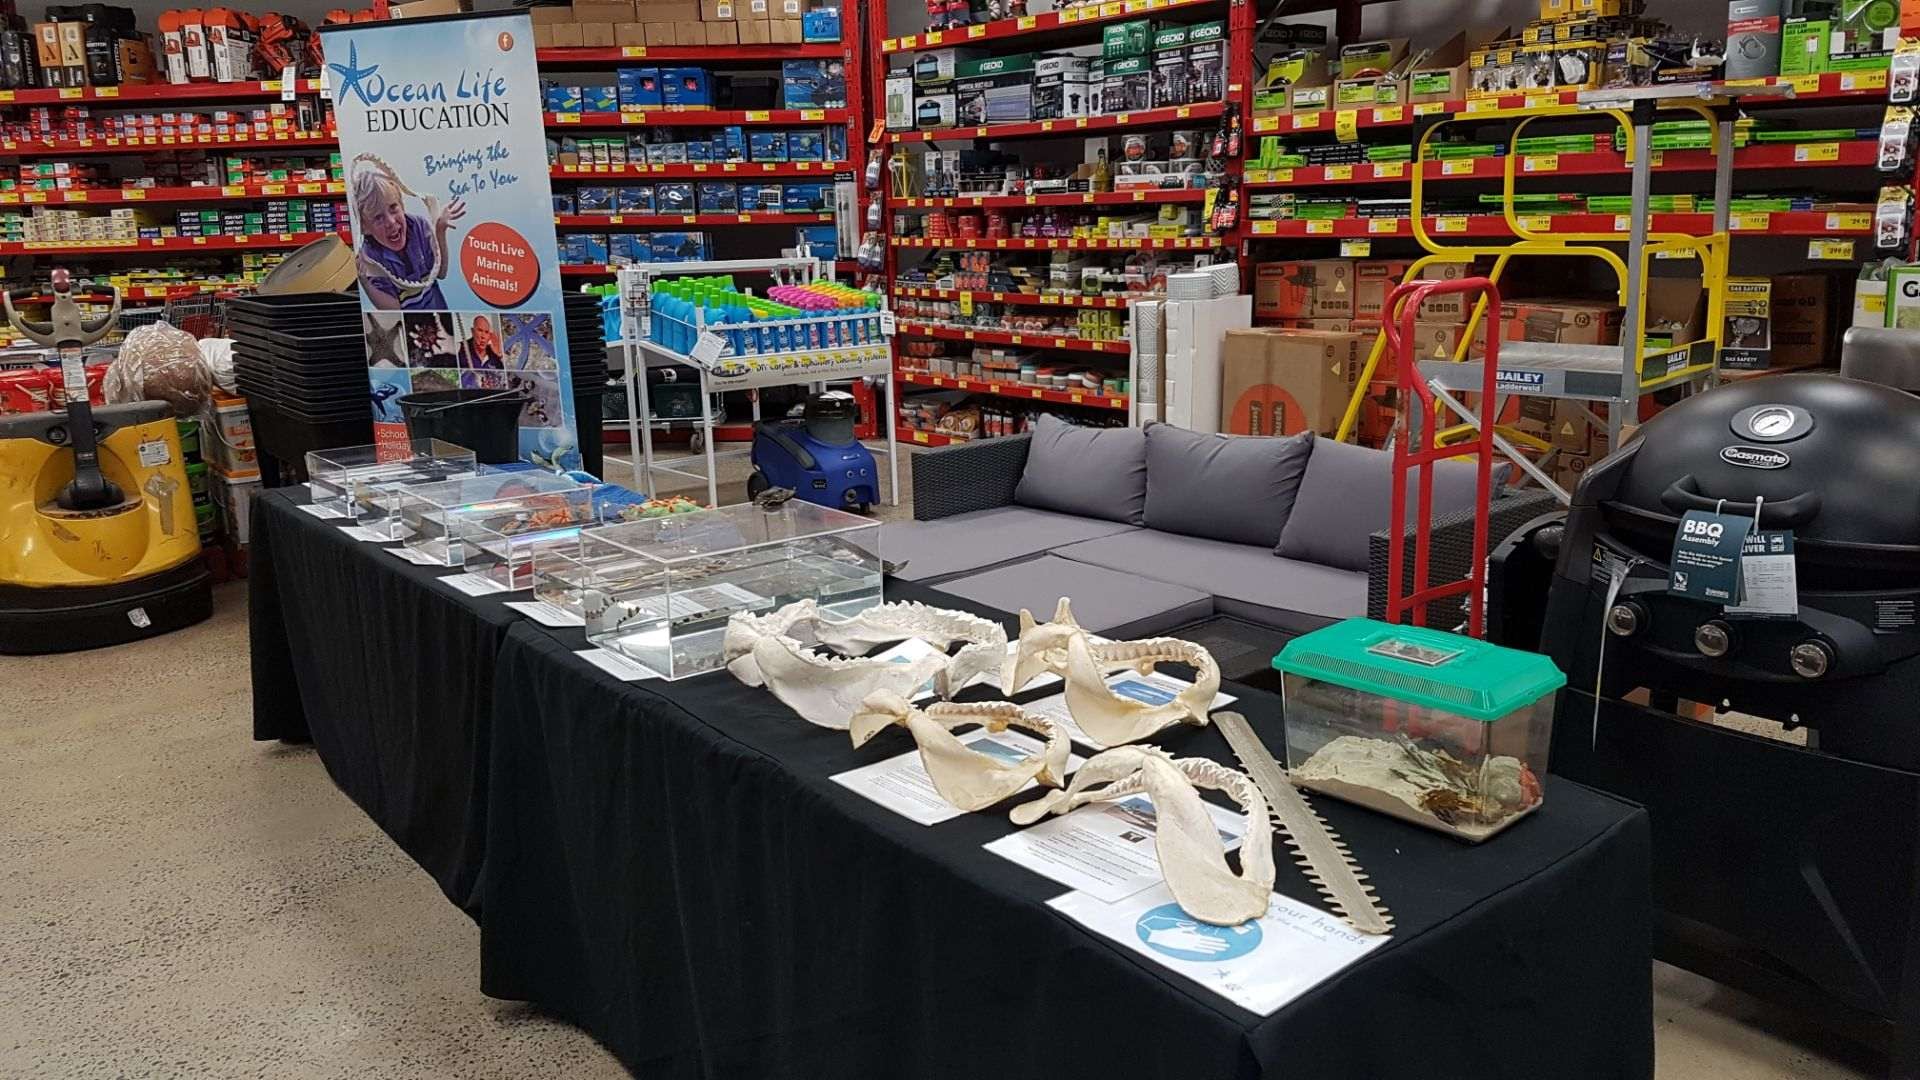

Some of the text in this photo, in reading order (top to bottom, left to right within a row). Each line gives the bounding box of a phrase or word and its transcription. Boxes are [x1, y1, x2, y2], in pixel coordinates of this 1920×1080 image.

[1160, 32, 1185, 44] GECKO
[1195, 26, 1221, 38] GECKO
[1117, 60, 1139, 70] GECKO
[366, 67, 507, 104] Ocean Life
[366, 102, 510, 132] EDUCATION
[424, 140, 509, 176] Bringing the
[448, 169, 518, 197] Sea To You
[468, 236, 525, 257] Touch Live
[476, 256, 513, 273] Marine
[472, 273, 518, 292] Animals!
[1902, 280, 1920, 297] G
[1496, 371, 1541, 383] BAILEY
[1725, 448, 1786, 463] Gasmate
[1683, 520, 1724, 537] BBQ
[1681, 534, 1720, 547] Assembly
[1312, 917, 1366, 946] hands
